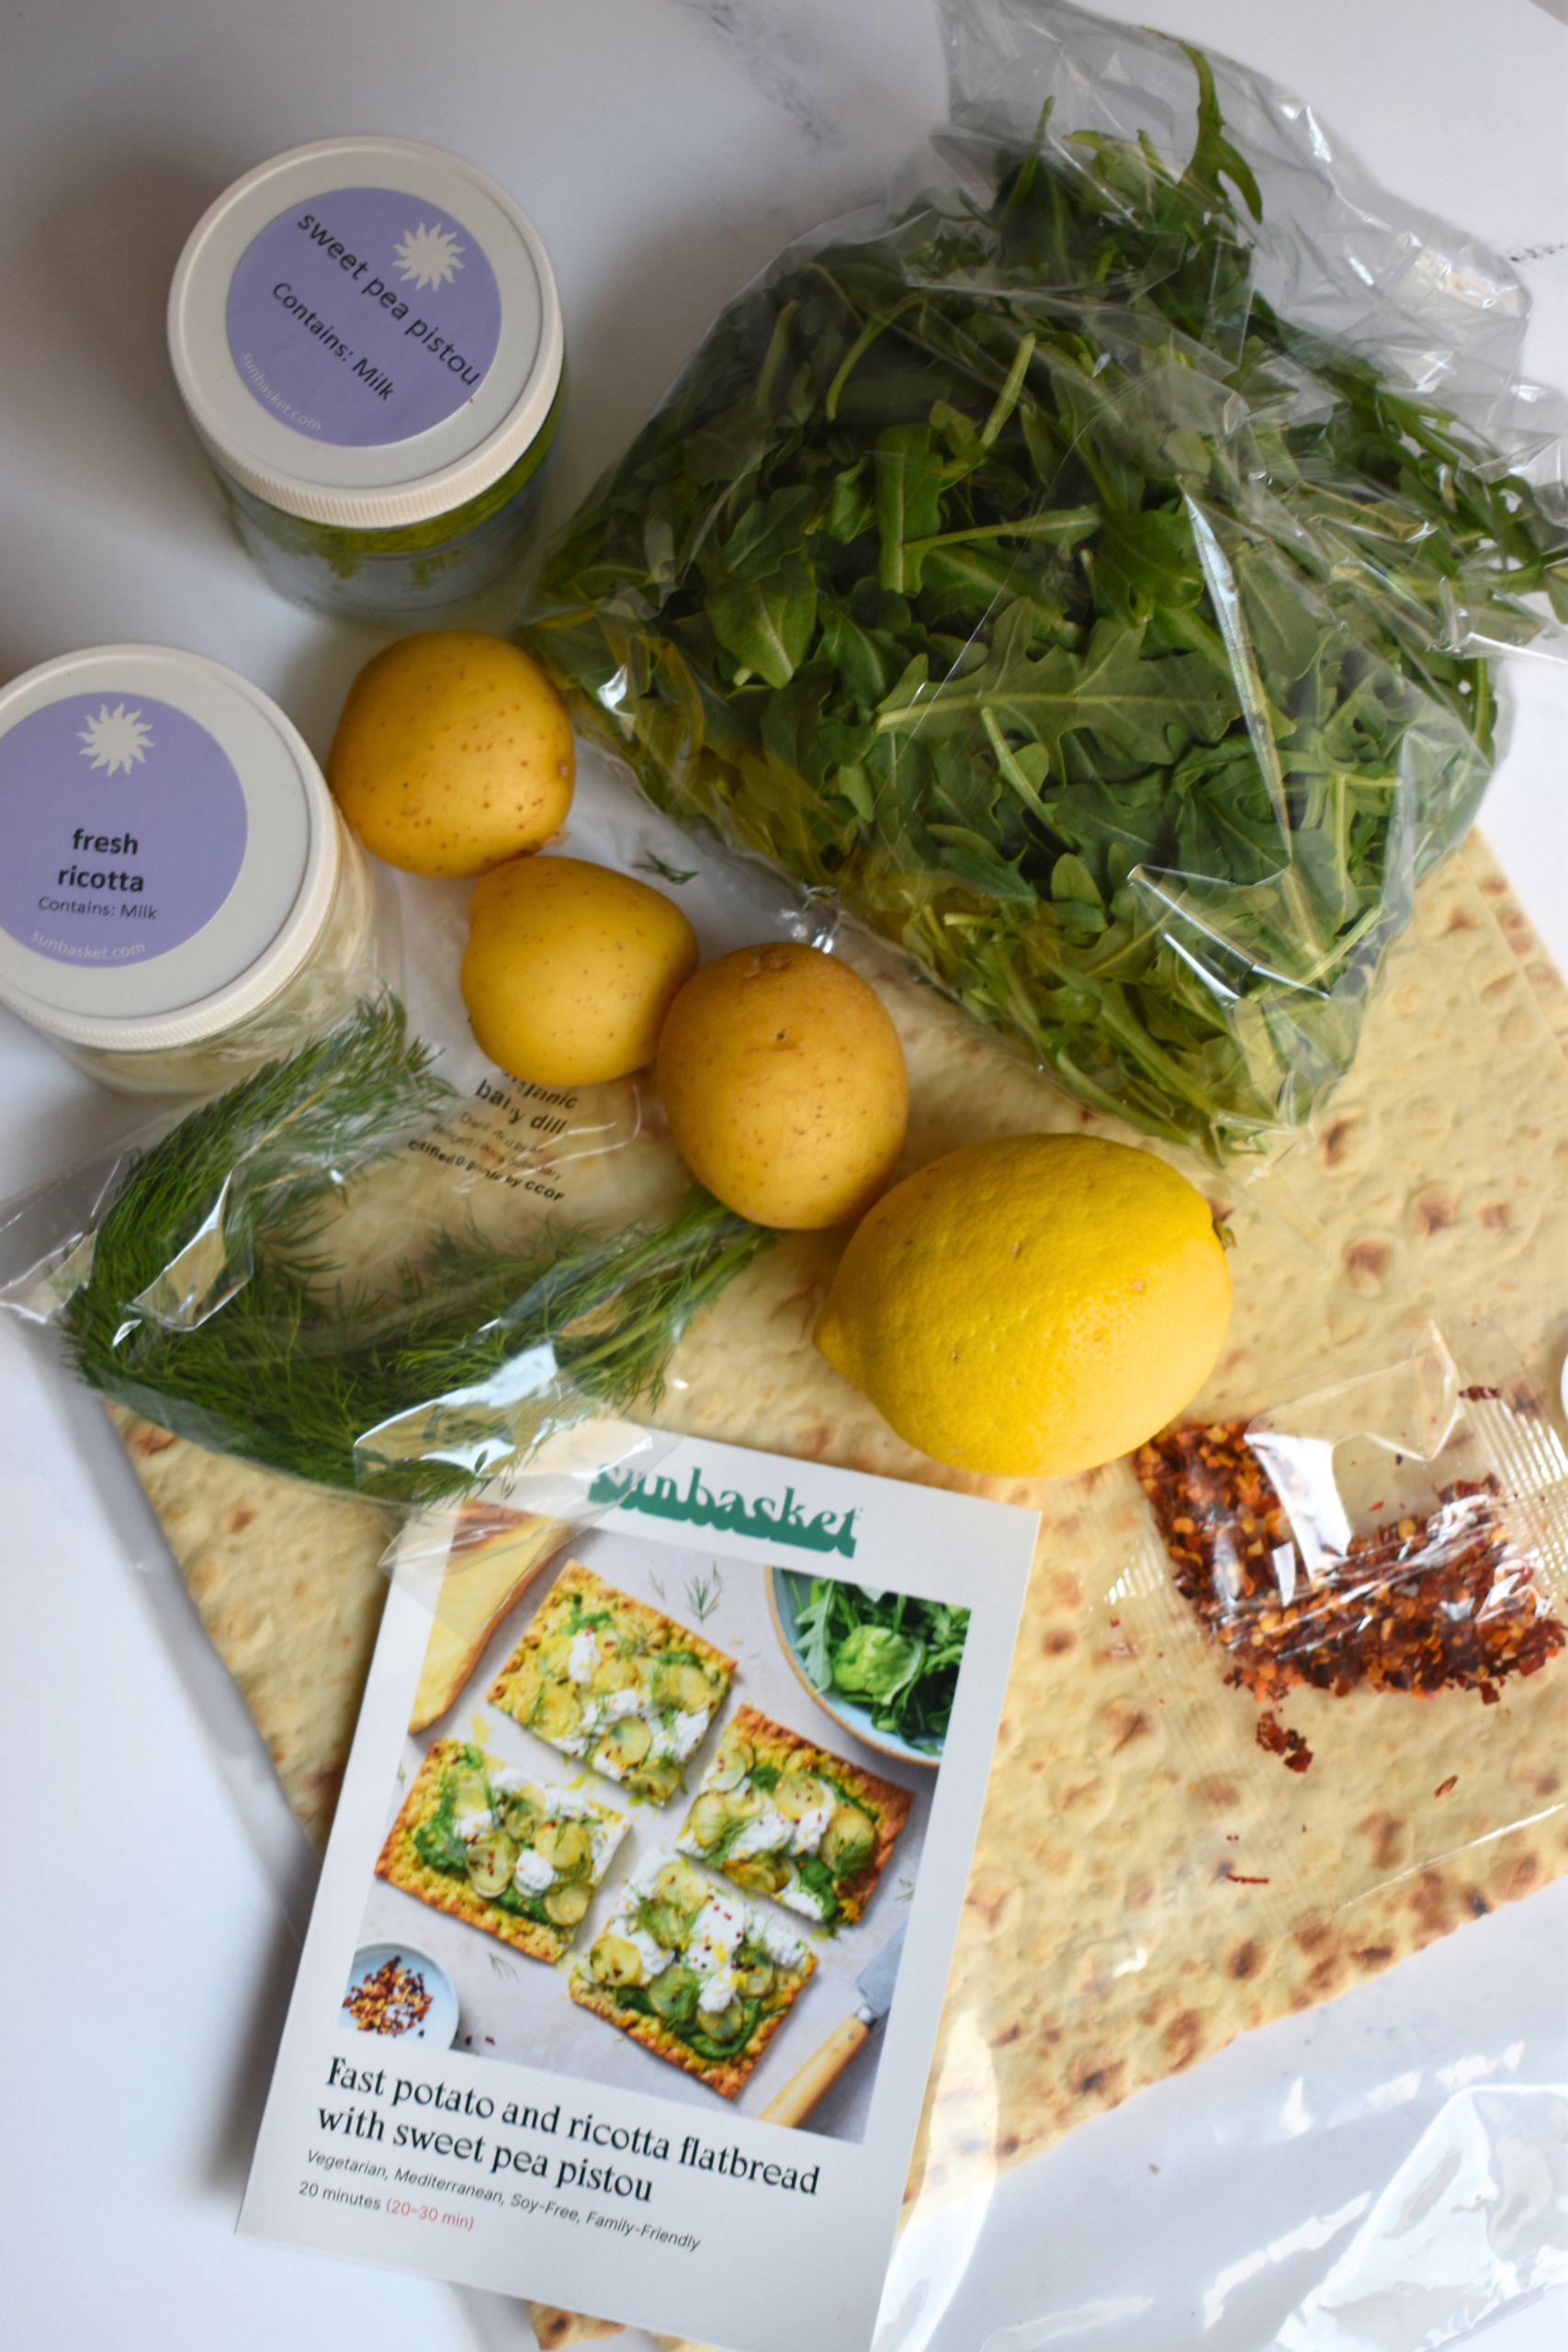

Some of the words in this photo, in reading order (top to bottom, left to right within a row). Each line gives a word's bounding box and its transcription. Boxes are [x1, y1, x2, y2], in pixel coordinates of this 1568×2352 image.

[298, 213, 369, 280] sweet
[362, 277, 410, 320] pea
[404, 317, 480, 386] pistou
[272, 282, 354, 362] Contains:
[352, 357, 395, 401] Milk
[242, 353, 321, 432] sunbasket.com
[73, 828, 139, 855] fresh
[39, 896, 116, 917] Contains:
[120, 901, 157, 920] Milk
[57, 865, 144, 892] ricotta
[31, 930, 146, 960] sunbasket.com
[530, 1114, 567, 1135] dill
[319, 2106, 385, 2142] with
[392, 2123, 486, 2164] sweet
[491, 2144, 549, 2177] pea
[555, 2158, 653, 2203] pistou
[326, 2055, 387, 2097] Fast
[390, 2077, 495, 2119] potato
[502, 2101, 561, 2135] and
[567, 2113, 670, 2161] ricotta
[679, 2135, 820, 2195] flatbread
[299, 2181, 319, 2197] 20
[322, 2188, 381, 2211] minutes
[442, 2211, 474, 2231] min)
[307, 2149, 389, 2181] Vegetarian,
[394, 2167, 505, 2206] Mediterranean,
[510, 2192, 581, 2224] Soy-Free,
[585, 2211, 701, 2252] Family-Friendly
